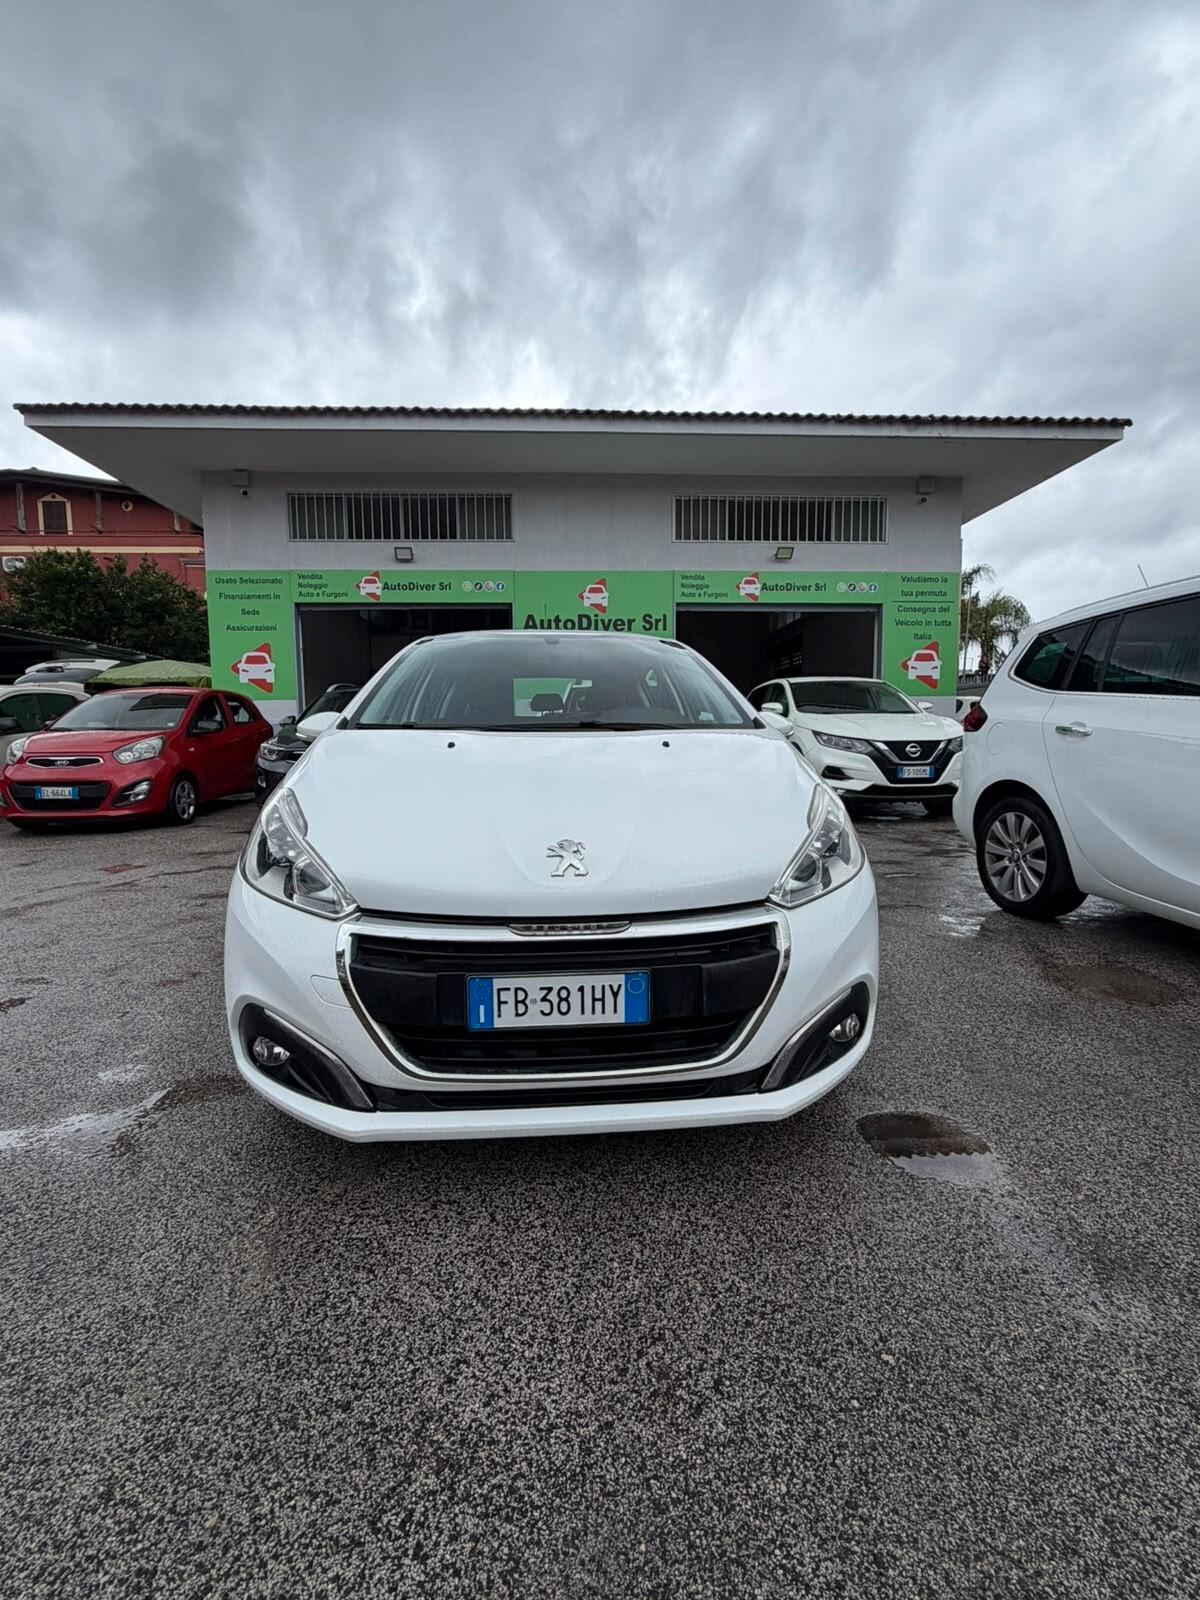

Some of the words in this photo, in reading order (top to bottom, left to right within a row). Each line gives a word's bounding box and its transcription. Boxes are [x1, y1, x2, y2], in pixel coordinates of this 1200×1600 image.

[239, 577, 283, 585] Selezionato
[901, 575, 939, 583] Valutiamo
[941, 575, 948, 583] la
[297, 582, 328, 590] Noleggio
[382, 581, 436, 592] AutoDiver
[439, 581, 451, 591] Srl
[680, 583, 710, 591] Noleggio
[761, 582, 812, 592] AutoDiver
[815, 582, 826, 592] Srl
[218, 592, 271, 600] Finanziamenti
[322, 591, 349, 599] Furgoni
[915, 590, 947, 598] permuta
[241, 608, 260, 616] Sede
[897, 605, 936, 614] Consegna
[938, 605, 950, 613] del
[523, 613, 636, 632] AutoDiver
[642, 613, 667, 632] Srl
[913, 632, 932, 640] Italia
[496, 987, 529, 1018] FB
[538, 983, 622, 1016] 381HY
